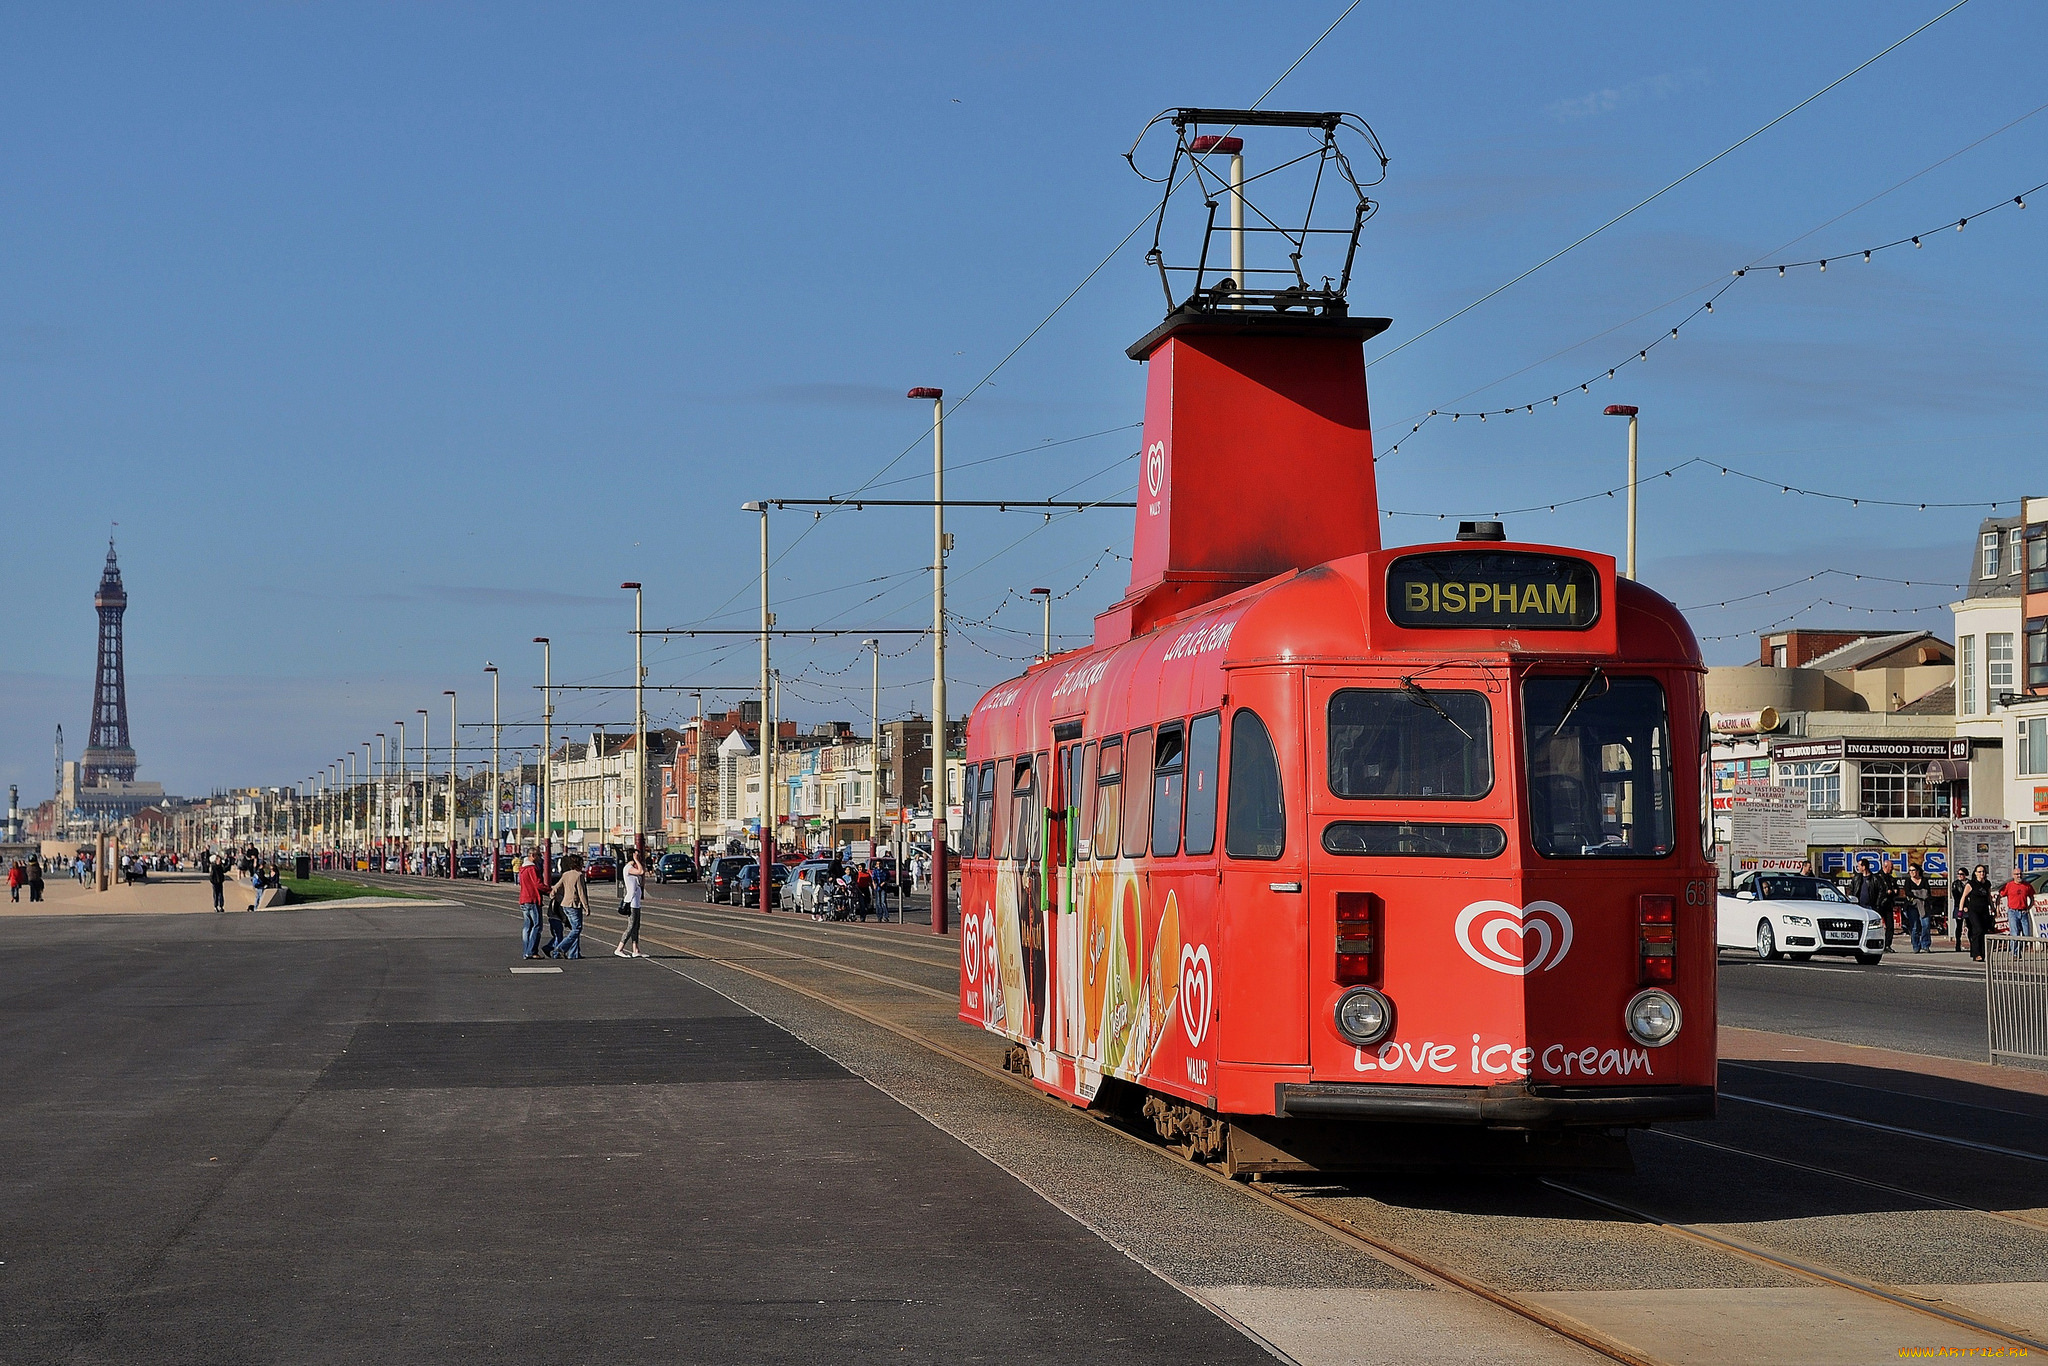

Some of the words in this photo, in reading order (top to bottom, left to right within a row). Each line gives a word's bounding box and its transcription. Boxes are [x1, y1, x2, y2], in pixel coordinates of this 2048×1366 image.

[1405, 581, 1577, 614] BISPHAM
[1847, 744, 1911, 754] INGLEWOOD
[1912, 745, 1947, 755] HOTEL
[1952, 743, 1966, 756] 419
[1740, 860, 1759, 870] HOT
[1762, 860, 1803, 869] DO-NUTS
[1685, 880, 1713, 906] 631
[1353, 1041, 1458, 1074] Love
[1470, 1033, 1536, 1075] ice
[1185, 1056, 1209, 1086] WALL'S
